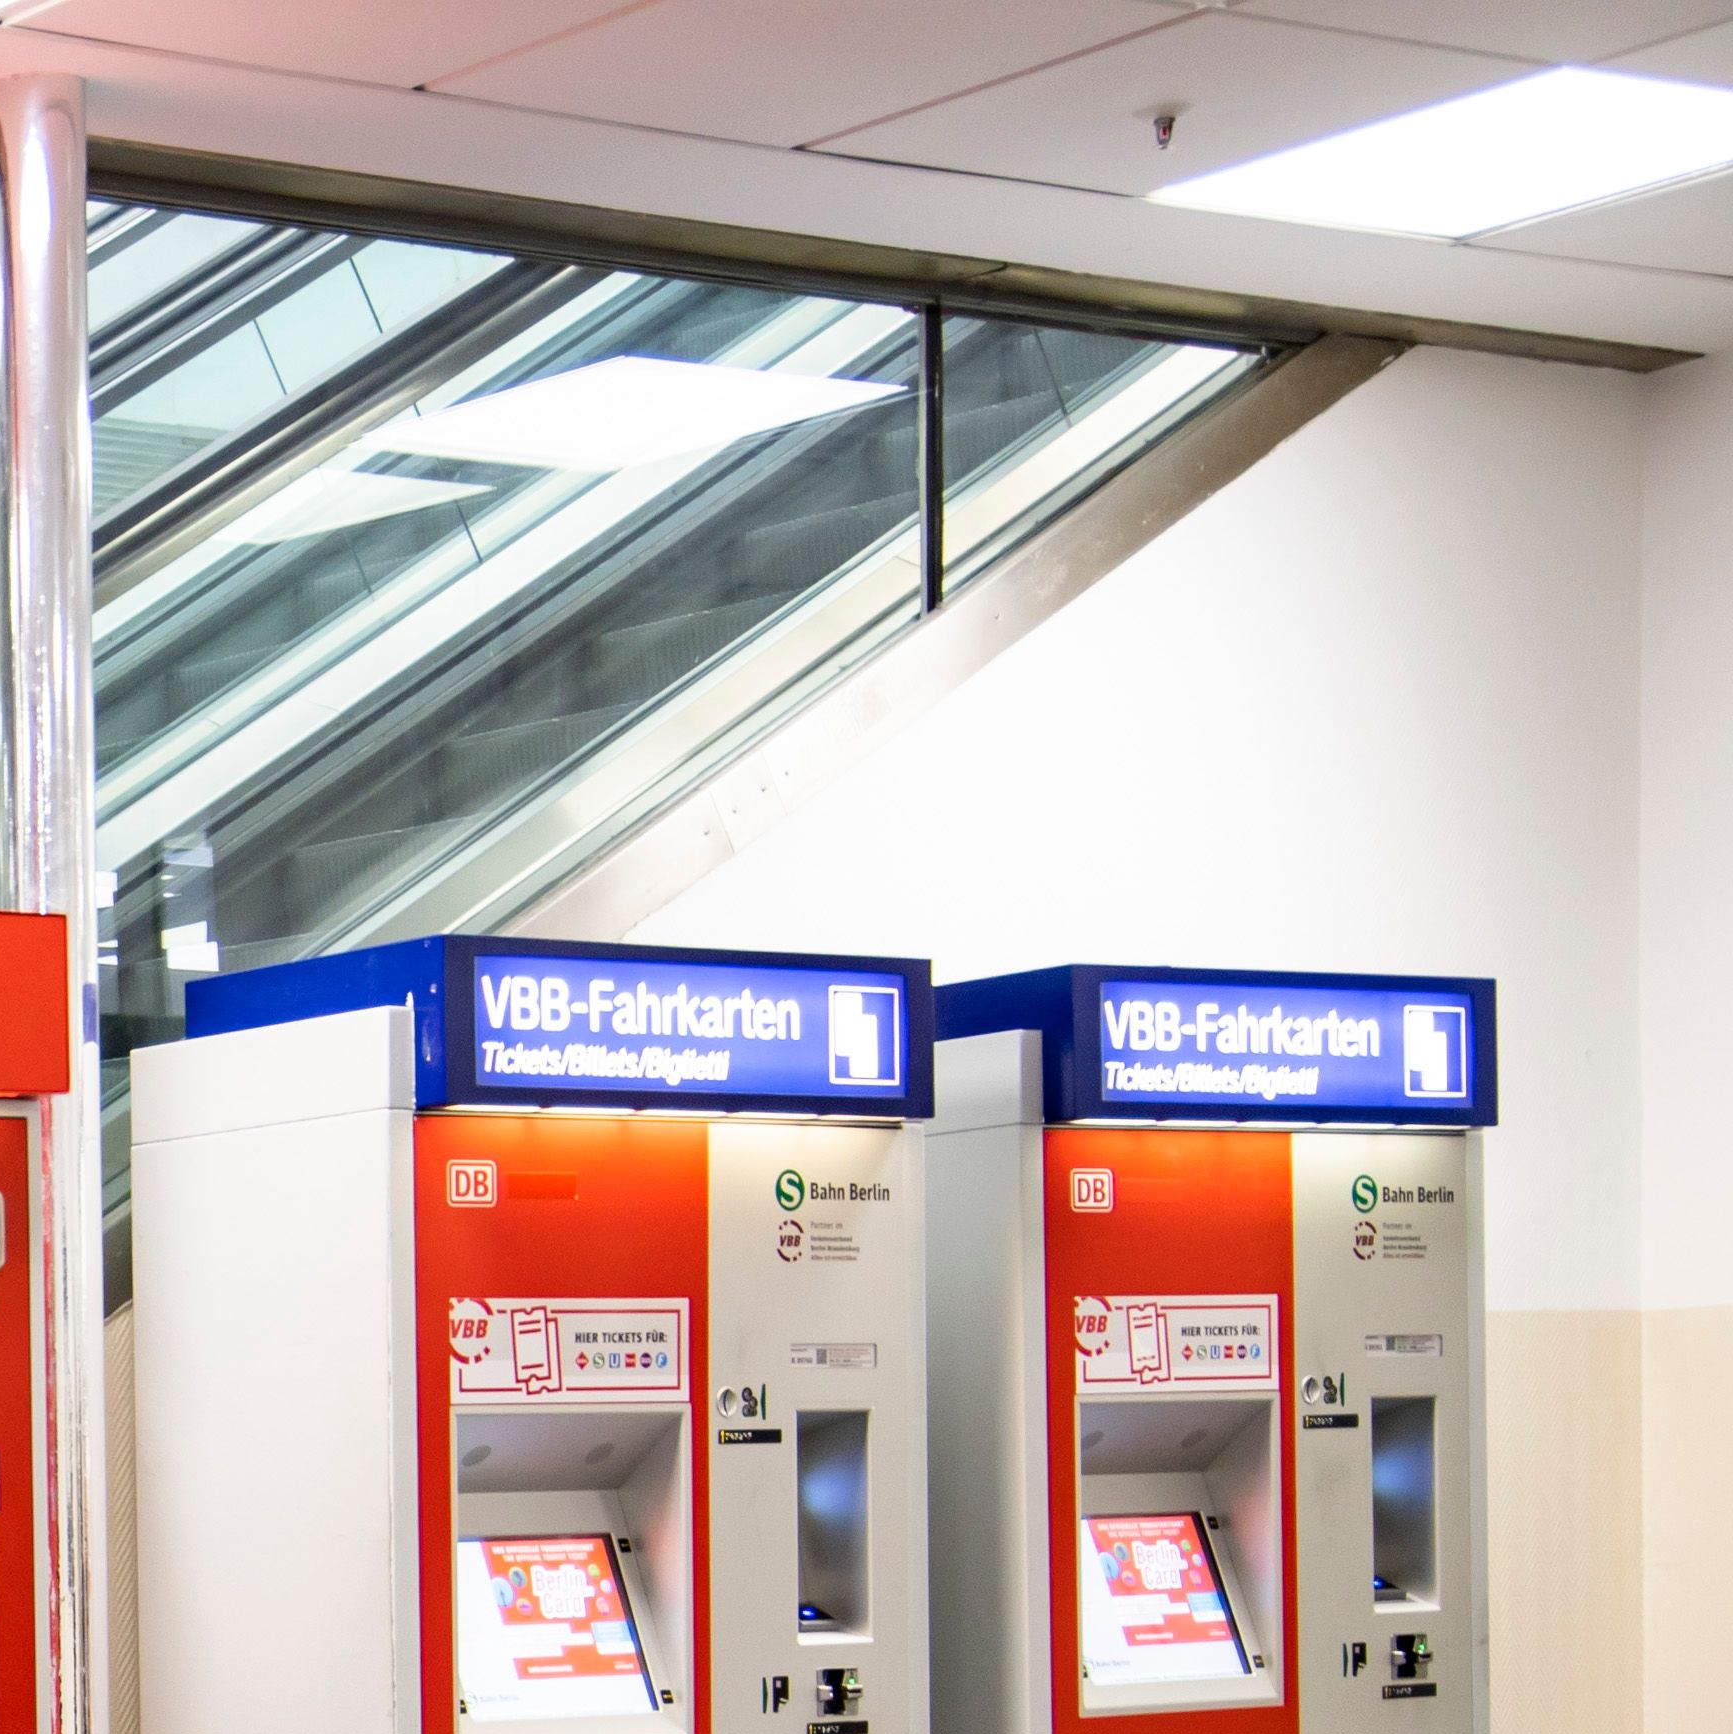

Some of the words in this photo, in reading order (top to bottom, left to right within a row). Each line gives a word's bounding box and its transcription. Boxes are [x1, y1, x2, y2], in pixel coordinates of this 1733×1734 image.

[481, 975, 802, 1041] VBB-Fahrkarten
[1103, 1000, 1381, 1058] VBB-Fahrkarten
[454, 1170, 489, 1198] DB
[810, 1182, 845, 1201] Bahn
[849, 1183, 890, 1202] Berlin
[1076, 1177, 1107, 1204] DB
[1382, 1187, 1414, 1203] Bahn
[1418, 1187, 1454, 1203] Berlin
[574, 1332, 599, 1344] HIER
[602, 1332, 642, 1343] TICKETS
[1181, 1327, 1201, 1337] HIER
[1204, 1326, 1239, 1336] TICKETS
[1135, 1545, 1178, 1565] Berlin
[535, 1569, 583, 1591] Berlin
[1144, 1566, 1178, 1585] Card
[544, 1592, 583, 1614] Card
